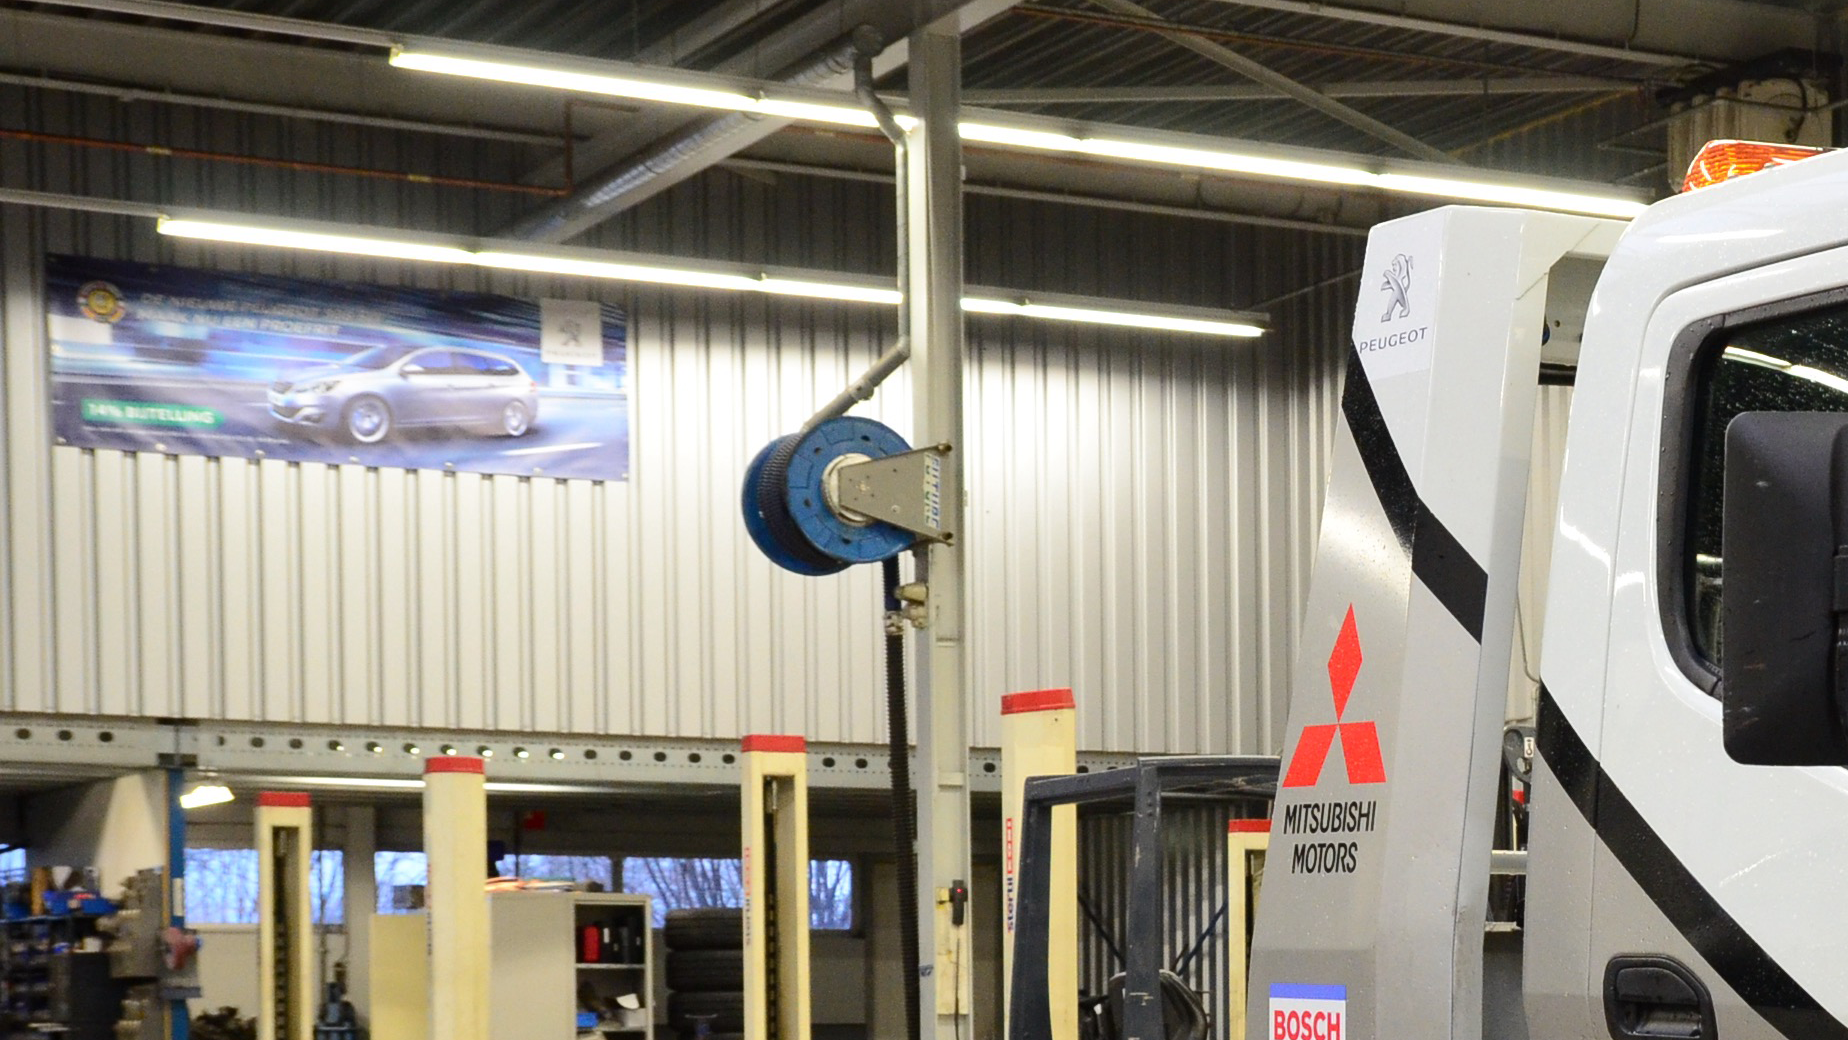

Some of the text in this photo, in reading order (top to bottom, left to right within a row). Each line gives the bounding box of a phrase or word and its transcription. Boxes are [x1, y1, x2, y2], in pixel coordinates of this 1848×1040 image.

[1360, 327, 1427, 354] PEUGEOT
[1283, 801, 1376, 834] MITSUBISHI
[1291, 842, 1358, 874] MOTORS
